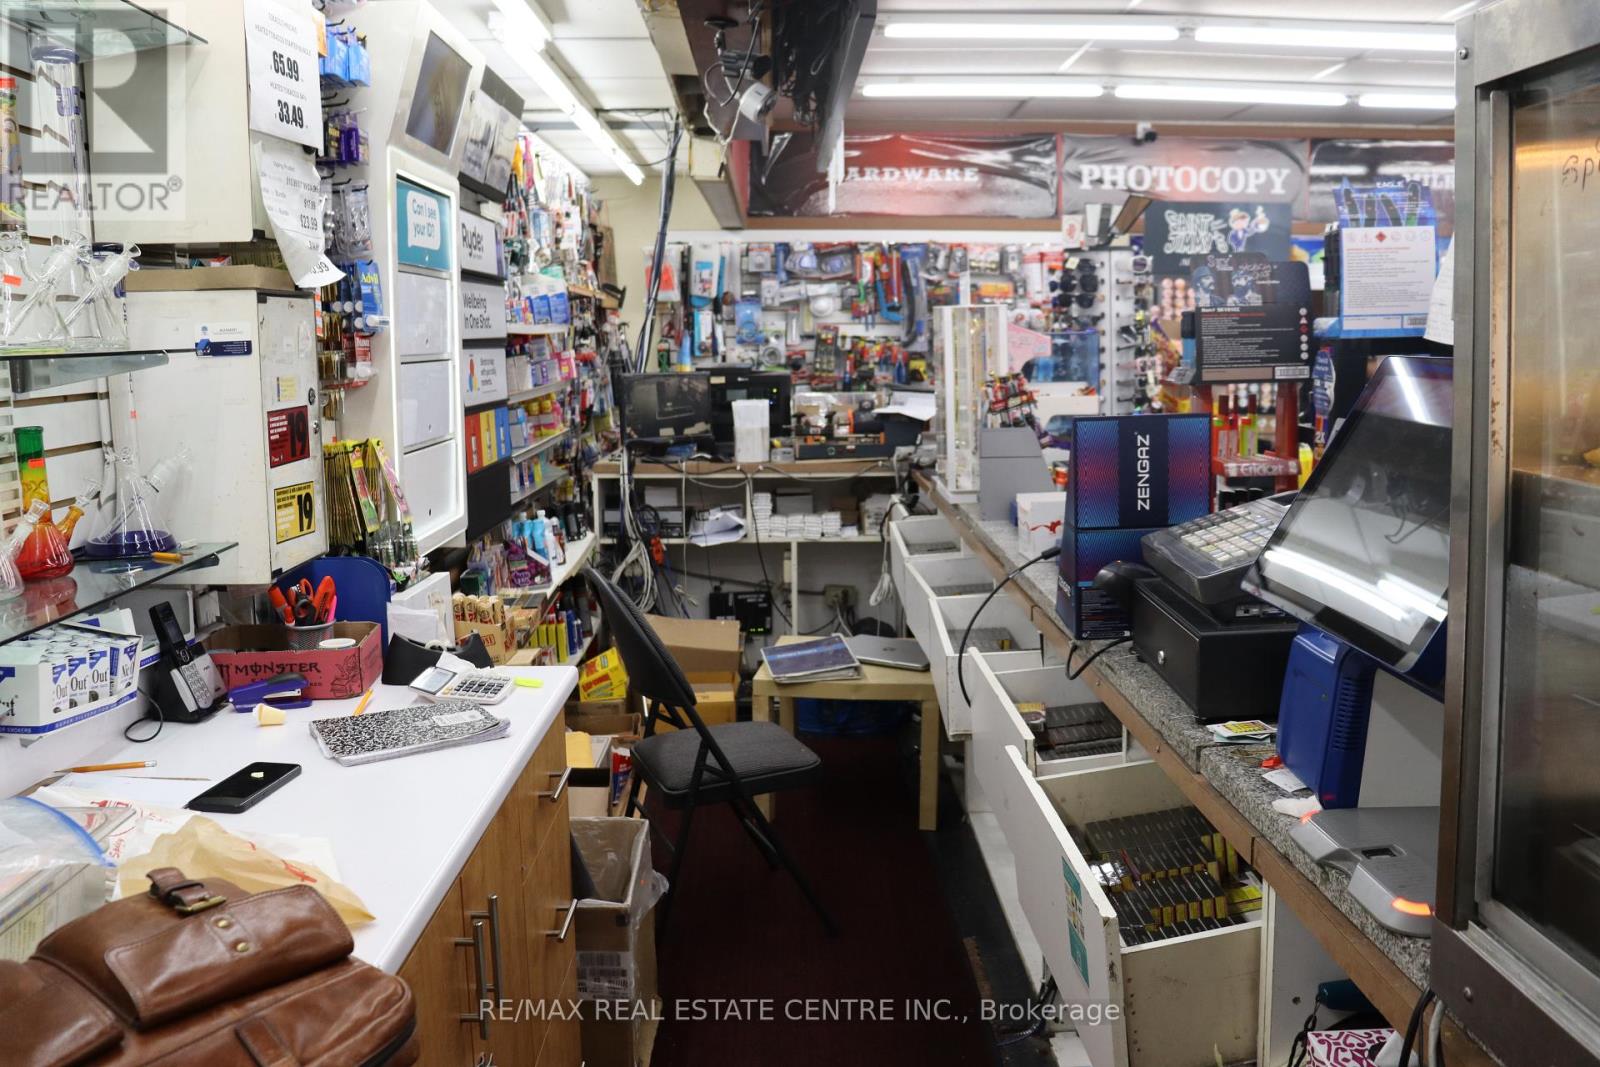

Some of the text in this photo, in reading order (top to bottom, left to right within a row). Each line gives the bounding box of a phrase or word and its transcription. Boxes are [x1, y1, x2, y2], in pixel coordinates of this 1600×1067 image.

[272, 50, 299, 81] 65.99
[277, 99, 304, 129] 33.49
[1079, 164, 1291, 194] PHOTOCOPY
[463, 293, 488, 313] Wellbeing
[1136, 433, 1151, 511] ZENGAZ
[297, 492, 313, 532] 19
[70, 676, 87, 691] Out
[92, 669, 107, 684] Out
[234, 661, 321, 677] MONSTER
